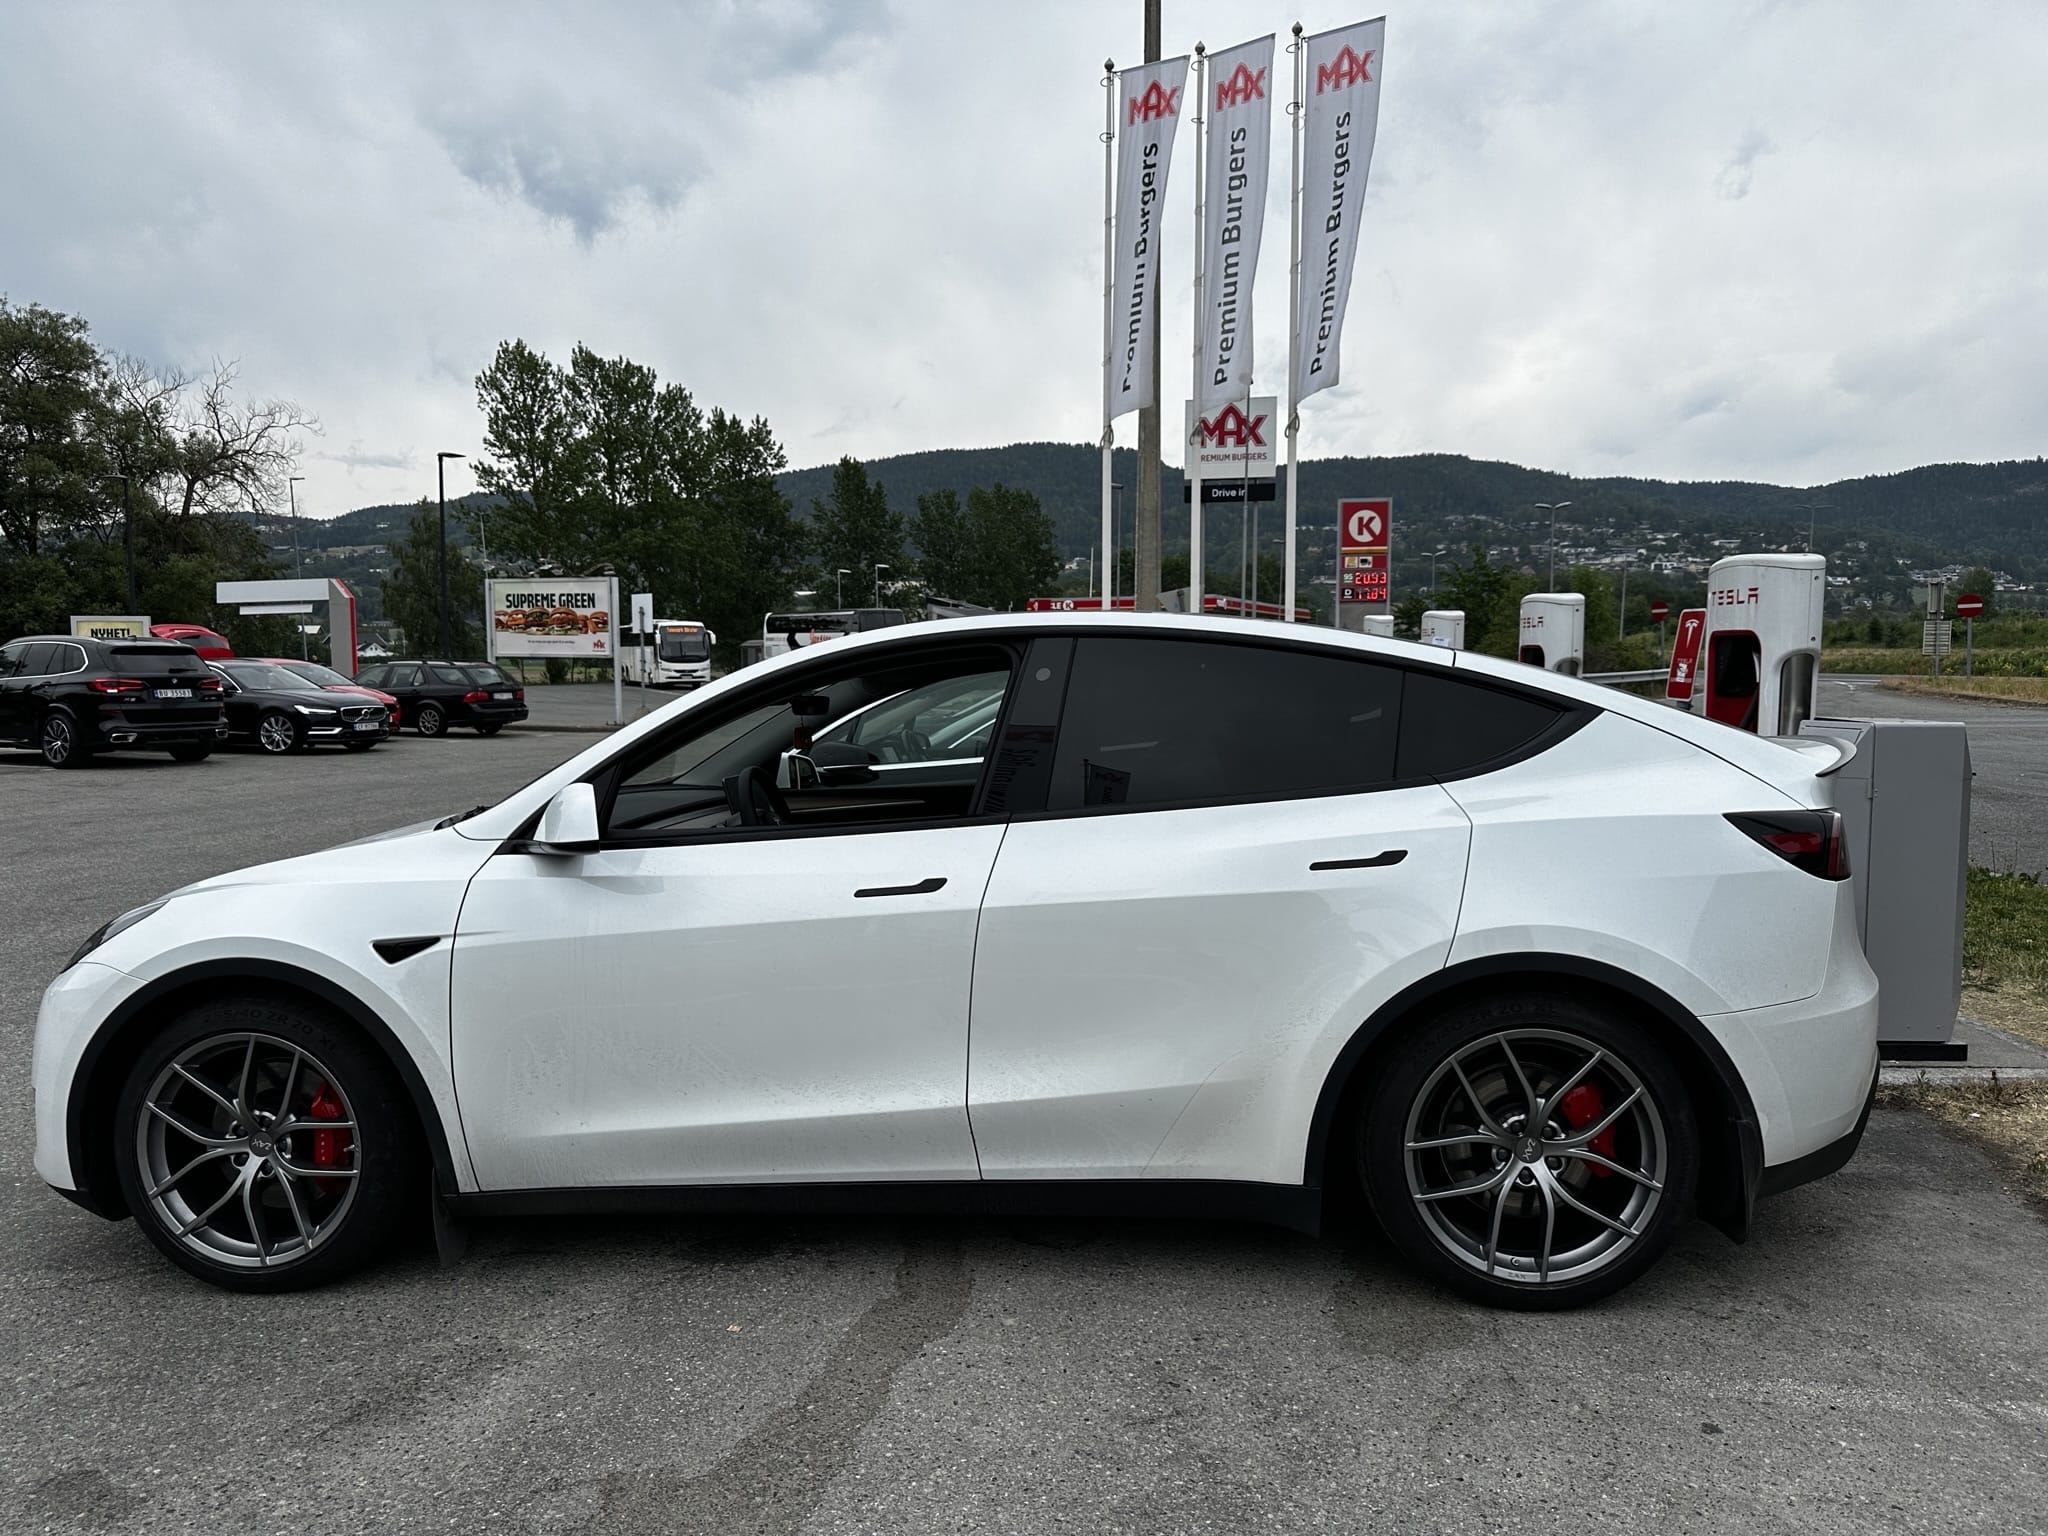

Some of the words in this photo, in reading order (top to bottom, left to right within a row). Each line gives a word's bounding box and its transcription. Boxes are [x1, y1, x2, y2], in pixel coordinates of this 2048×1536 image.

[1215, 61, 1268, 113] MAX
[1316, 43, 1377, 96] MAX
[1127, 79, 1181, 128] MAX
[1134, 141, 1159, 260] Burgers
[1222, 126, 1248, 247] Burgers
[1310, 236, 1340, 377] Premium
[1325, 110, 1351, 235] Burgers
[1213, 250, 1241, 387] Premium
[1200, 402, 1268, 449] MAX
[1200, 453, 1231, 463] REMIUM
[1232, 451, 1268, 462] BURGERS
[1212, 488, 1237, 498] Drive
[1357, 516, 1376, 536] K
[505, 592, 556, 609] SUPREME
[558, 592, 596, 609] GREEN
[1344, 588, 1353, 596] D
[1712, 587, 1759, 607] TESLA
